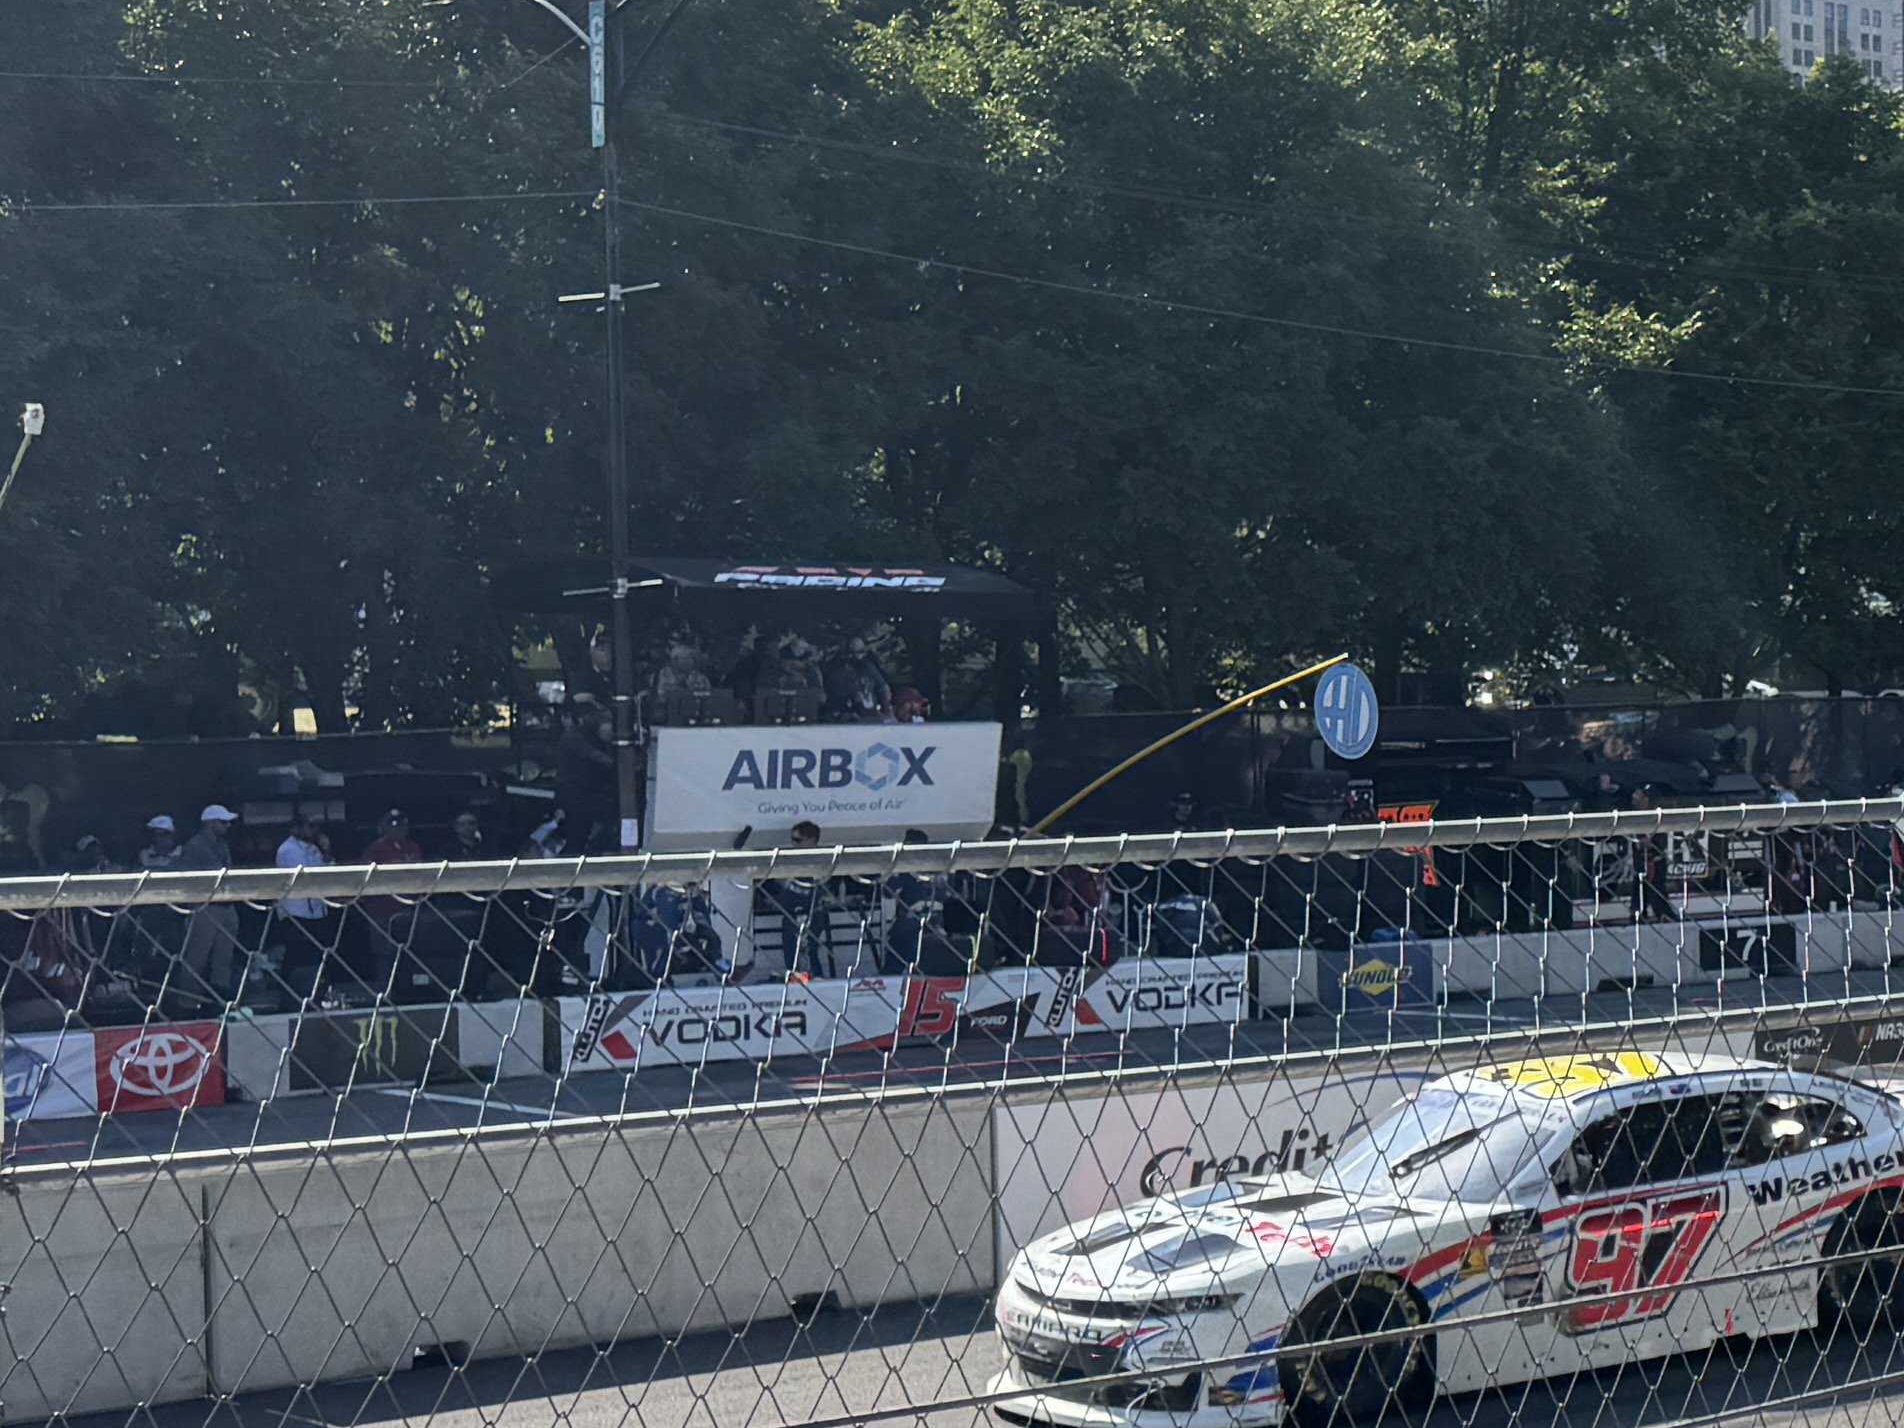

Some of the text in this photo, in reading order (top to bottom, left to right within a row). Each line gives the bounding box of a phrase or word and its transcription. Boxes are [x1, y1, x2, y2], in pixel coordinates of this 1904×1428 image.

[721, 741, 937, 792] AIRBOX
[757, 800, 799, 816] Giving
[802, 800, 827, 813] You
[828, 800, 868, 813] Peace
[869, 798, 884, 812] of
[1735, 929, 1758, 963] 7
[902, 976, 965, 1037] 15
[1105, 979, 1245, 1014] VODKA
[643, 1010, 808, 1047] VODKA
[970, 1014, 1008, 1029] FORD
[1139, 1128, 1333, 1199] Credit
[1570, 1186, 1724, 1334] 97
